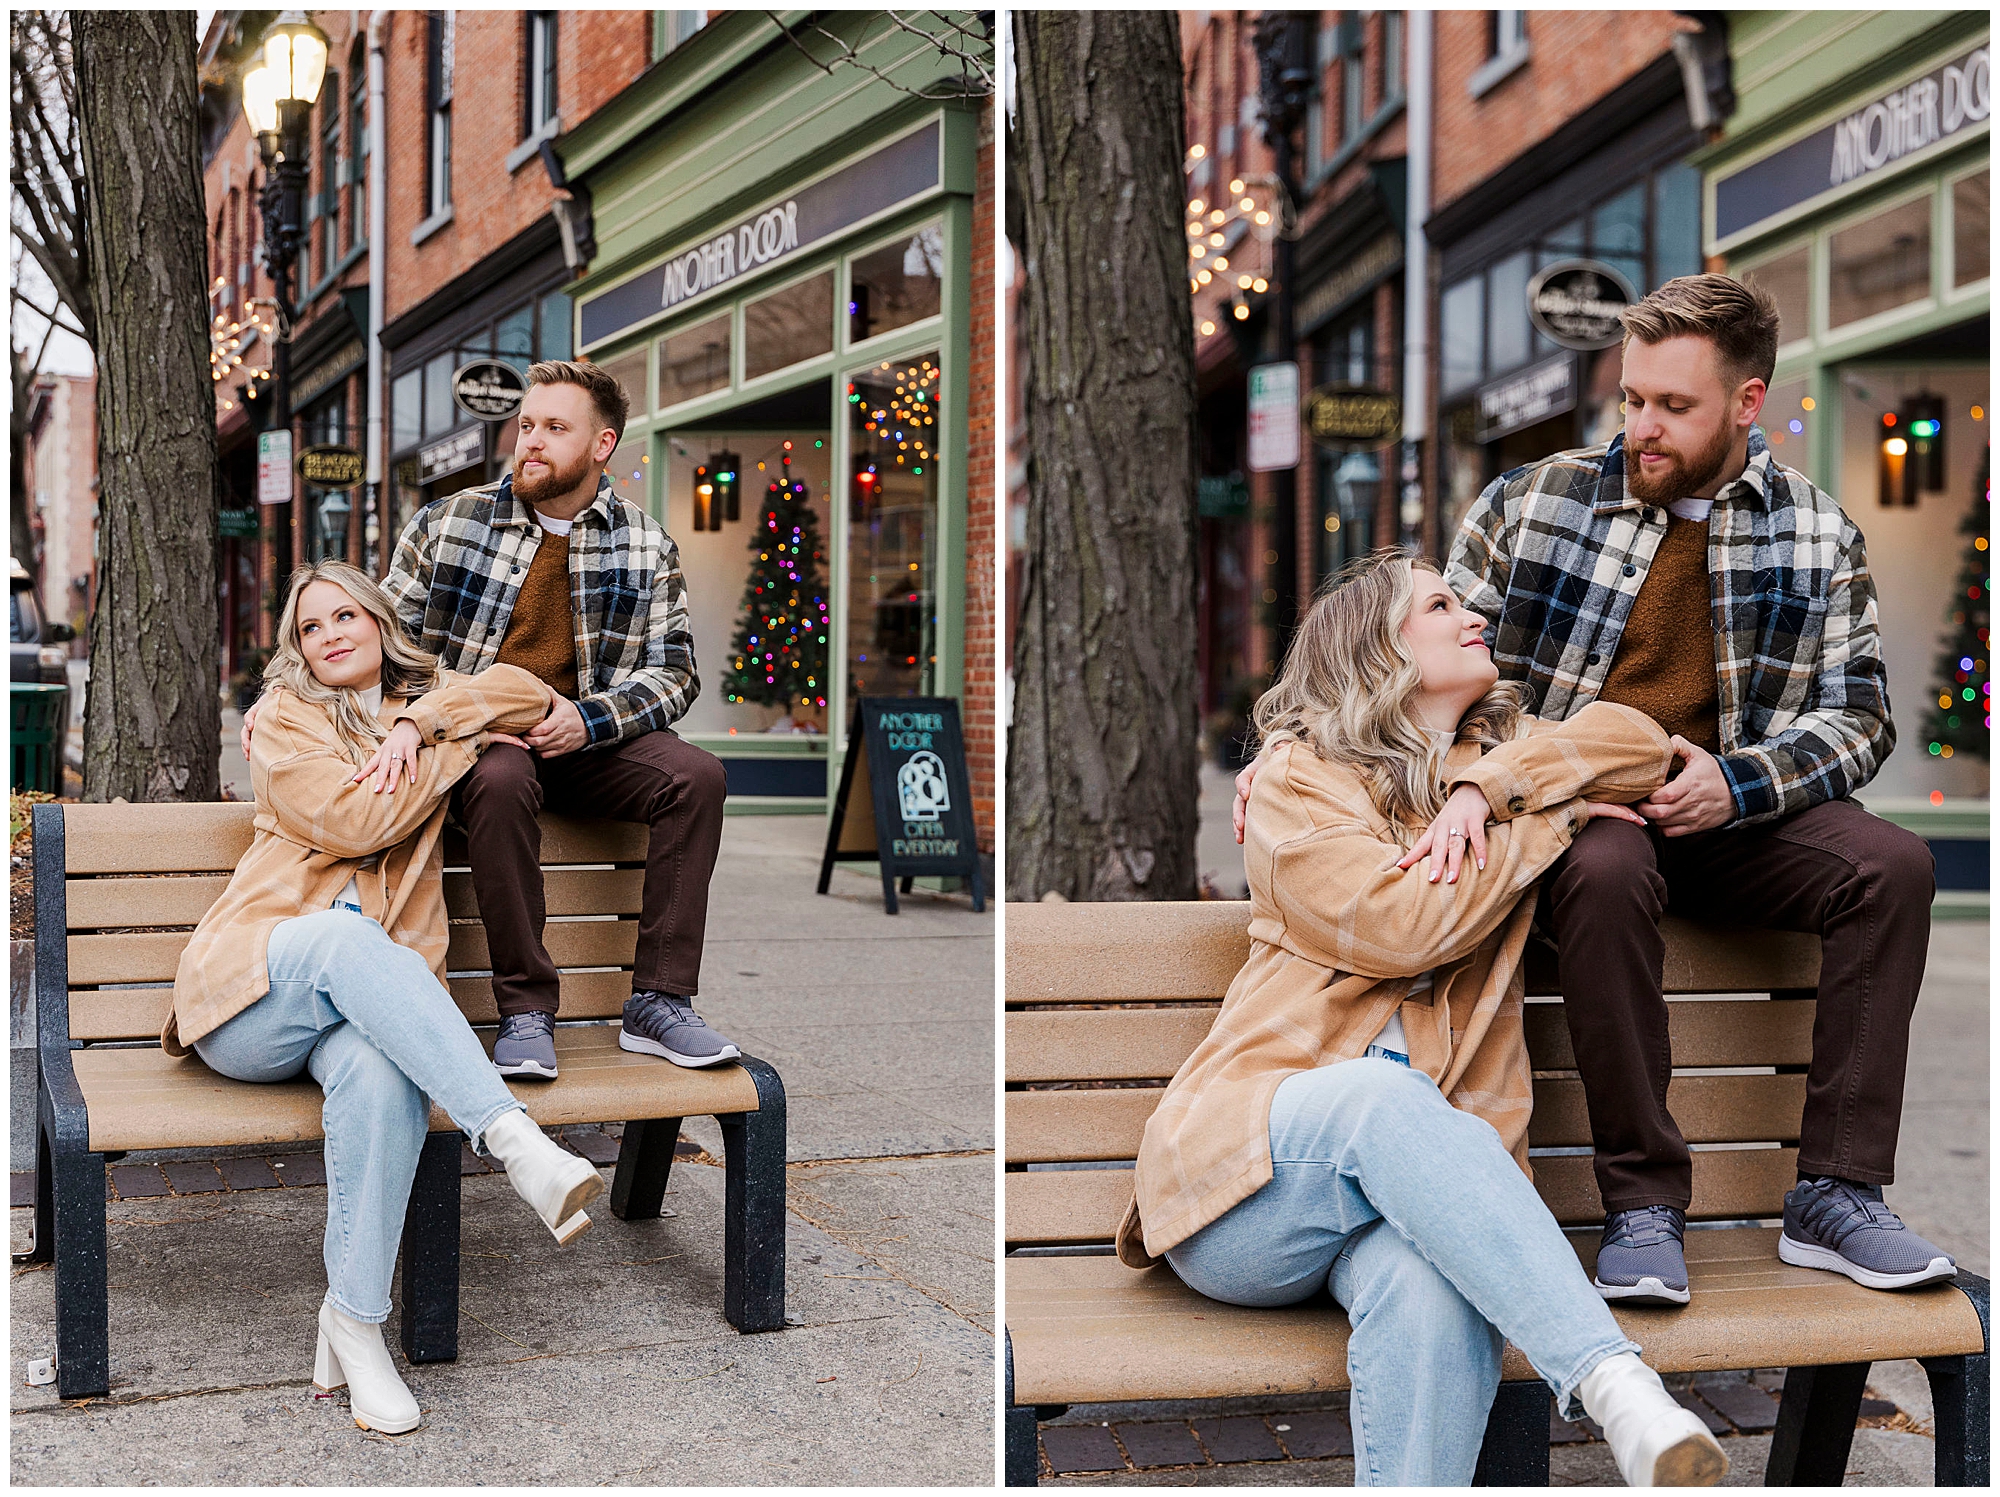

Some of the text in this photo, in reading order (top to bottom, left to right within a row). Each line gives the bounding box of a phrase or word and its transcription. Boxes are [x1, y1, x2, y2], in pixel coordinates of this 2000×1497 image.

[1830, 77, 1940, 185] ANOTHER
[661, 200, 798, 308] ANOTHER DOOR
[879, 712, 944, 731] ANOTHER
[888, 732, 934, 751] DOOR
[904, 820, 945, 838] OPEN
[892, 839, 960, 856] EVERYDAY
